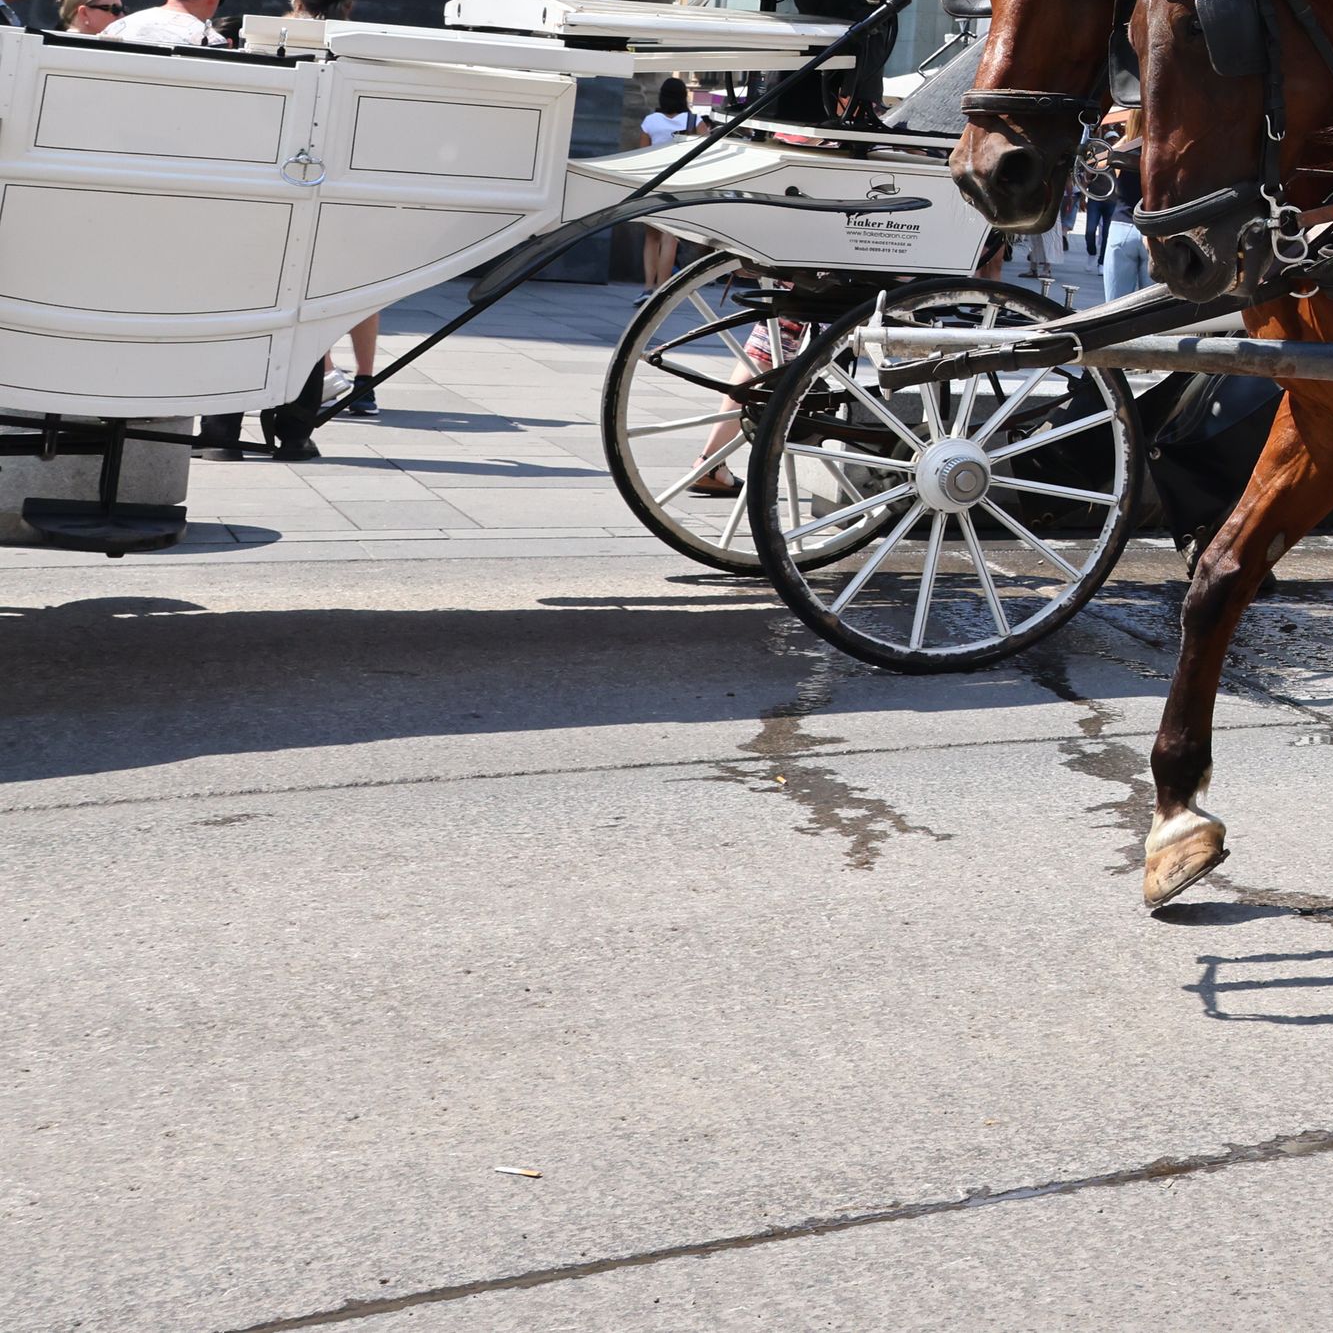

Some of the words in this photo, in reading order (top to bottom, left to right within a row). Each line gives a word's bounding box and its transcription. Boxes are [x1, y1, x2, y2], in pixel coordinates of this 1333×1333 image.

[846, 217, 884, 228] Fiaker
[886, 220, 920, 231] Baron
[846, 230, 918, 240] www.fiakerbaron.com
